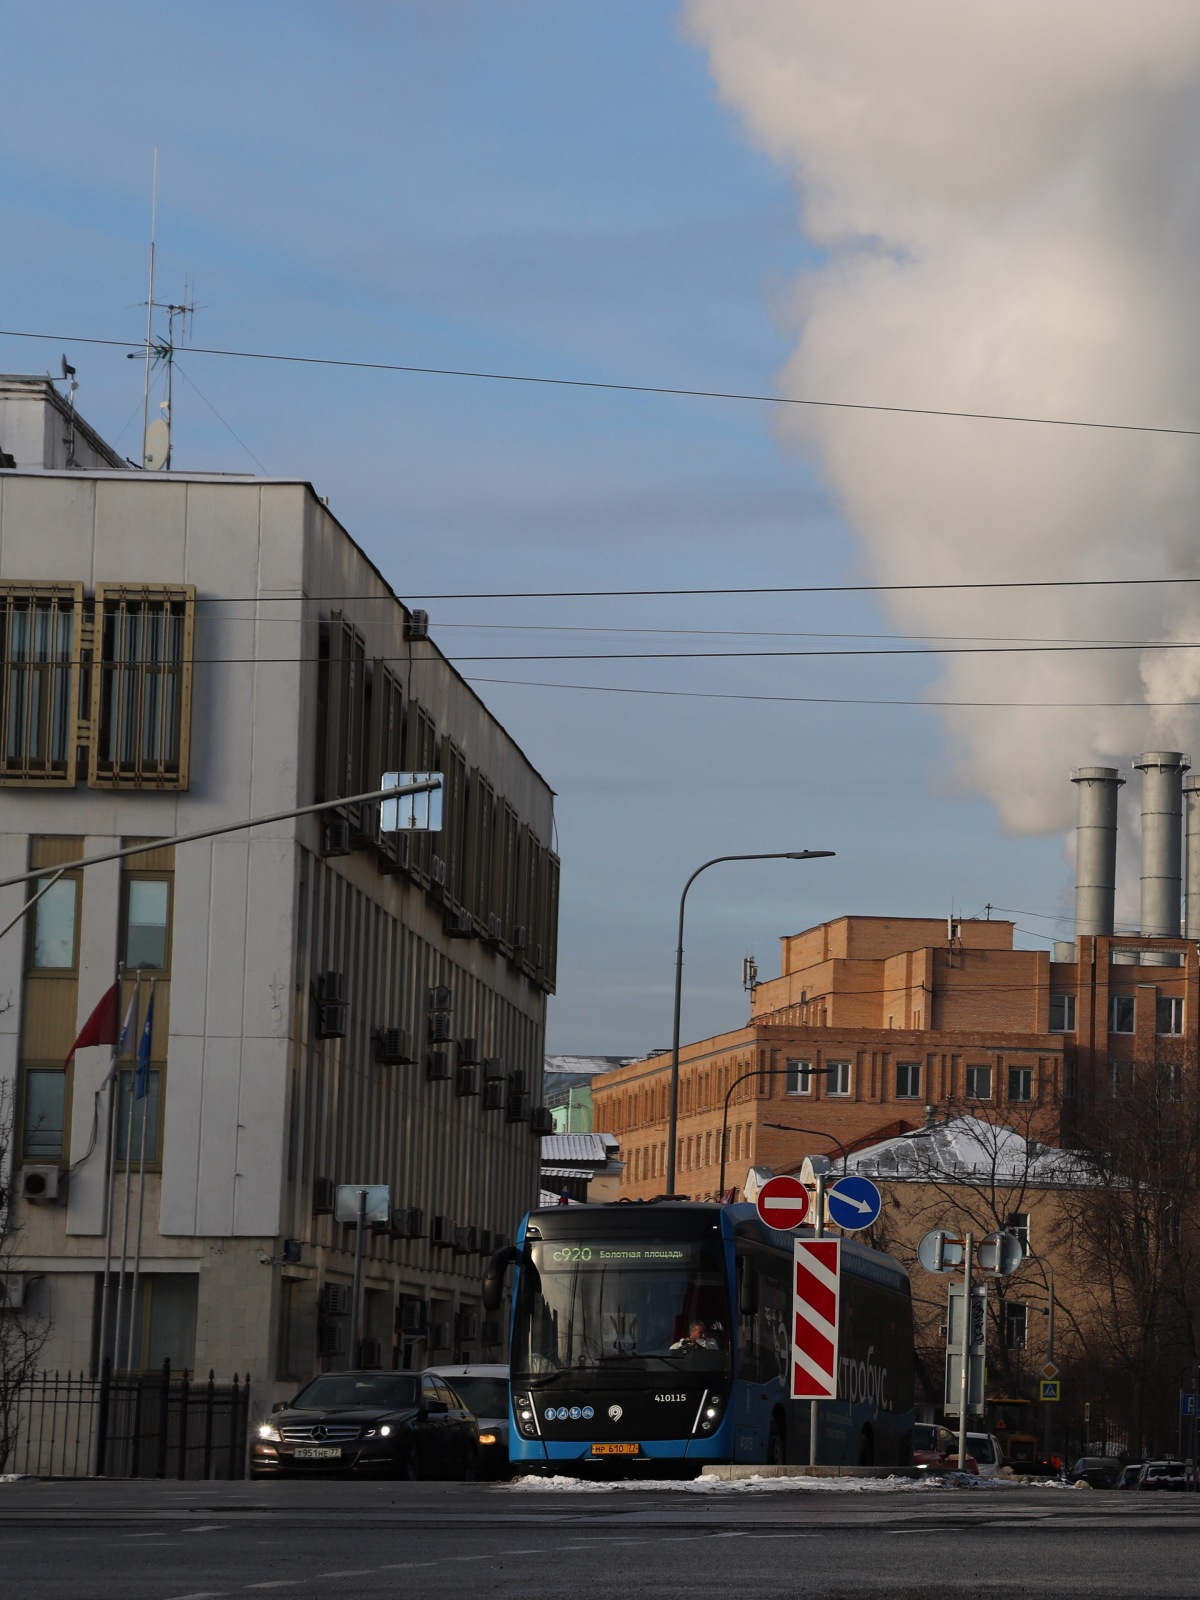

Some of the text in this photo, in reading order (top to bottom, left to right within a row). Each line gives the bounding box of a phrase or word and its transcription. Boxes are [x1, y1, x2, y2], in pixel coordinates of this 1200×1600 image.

[553, 1247, 683, 1262] с920 Болотная площадь
[778, 1322, 893, 1421] Эктробус.
[654, 1393, 687, 1402] 410115
[297, 1448, 329, 1457] Т951НЕ
[608, 1444, 624, 1453] 610
